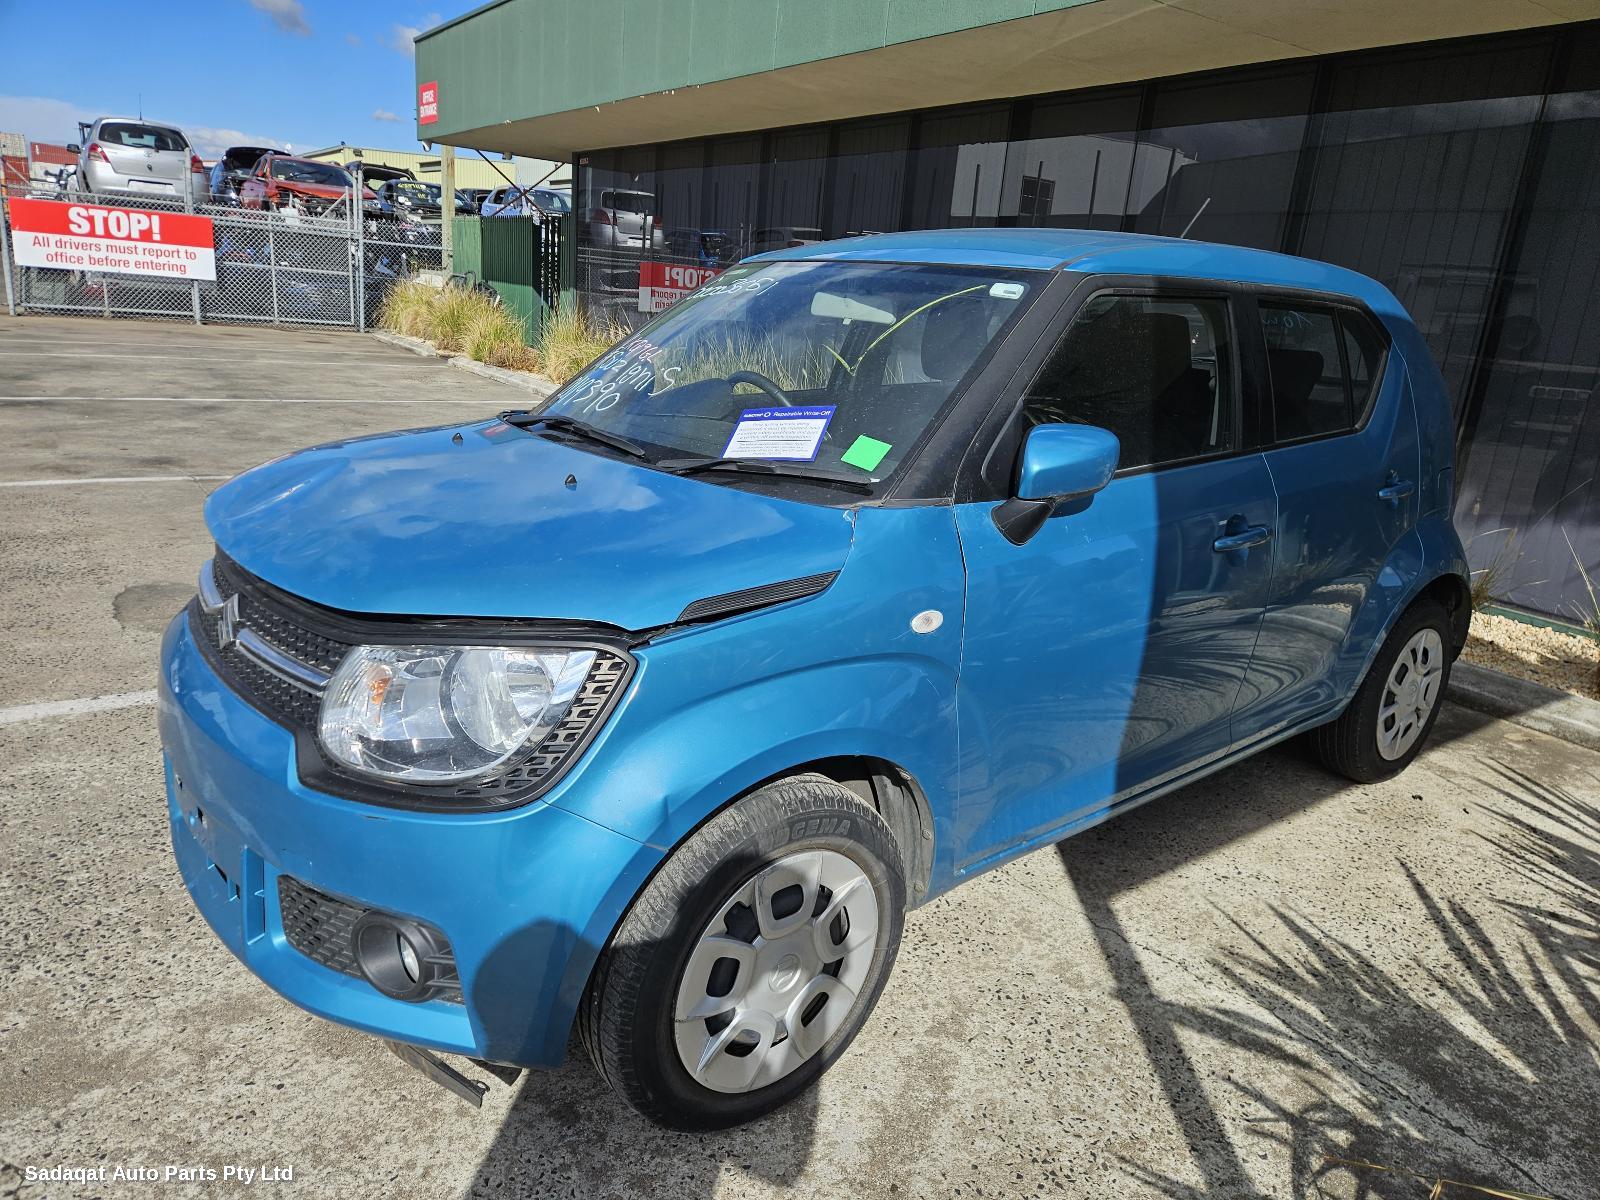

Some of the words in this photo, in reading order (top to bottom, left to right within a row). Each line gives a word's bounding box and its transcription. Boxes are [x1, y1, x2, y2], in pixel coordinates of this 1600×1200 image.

[67, 206, 161, 241] STOP!
[32, 235, 50, 249] All
[54, 238, 102, 252] drivers
[106, 244, 139, 256] must
[142, 246, 182, 261] report
[185, 250, 197, 261] to
[46, 251, 84, 265] office
[88, 254, 130, 269] before
[134, 259, 187, 275] entering
